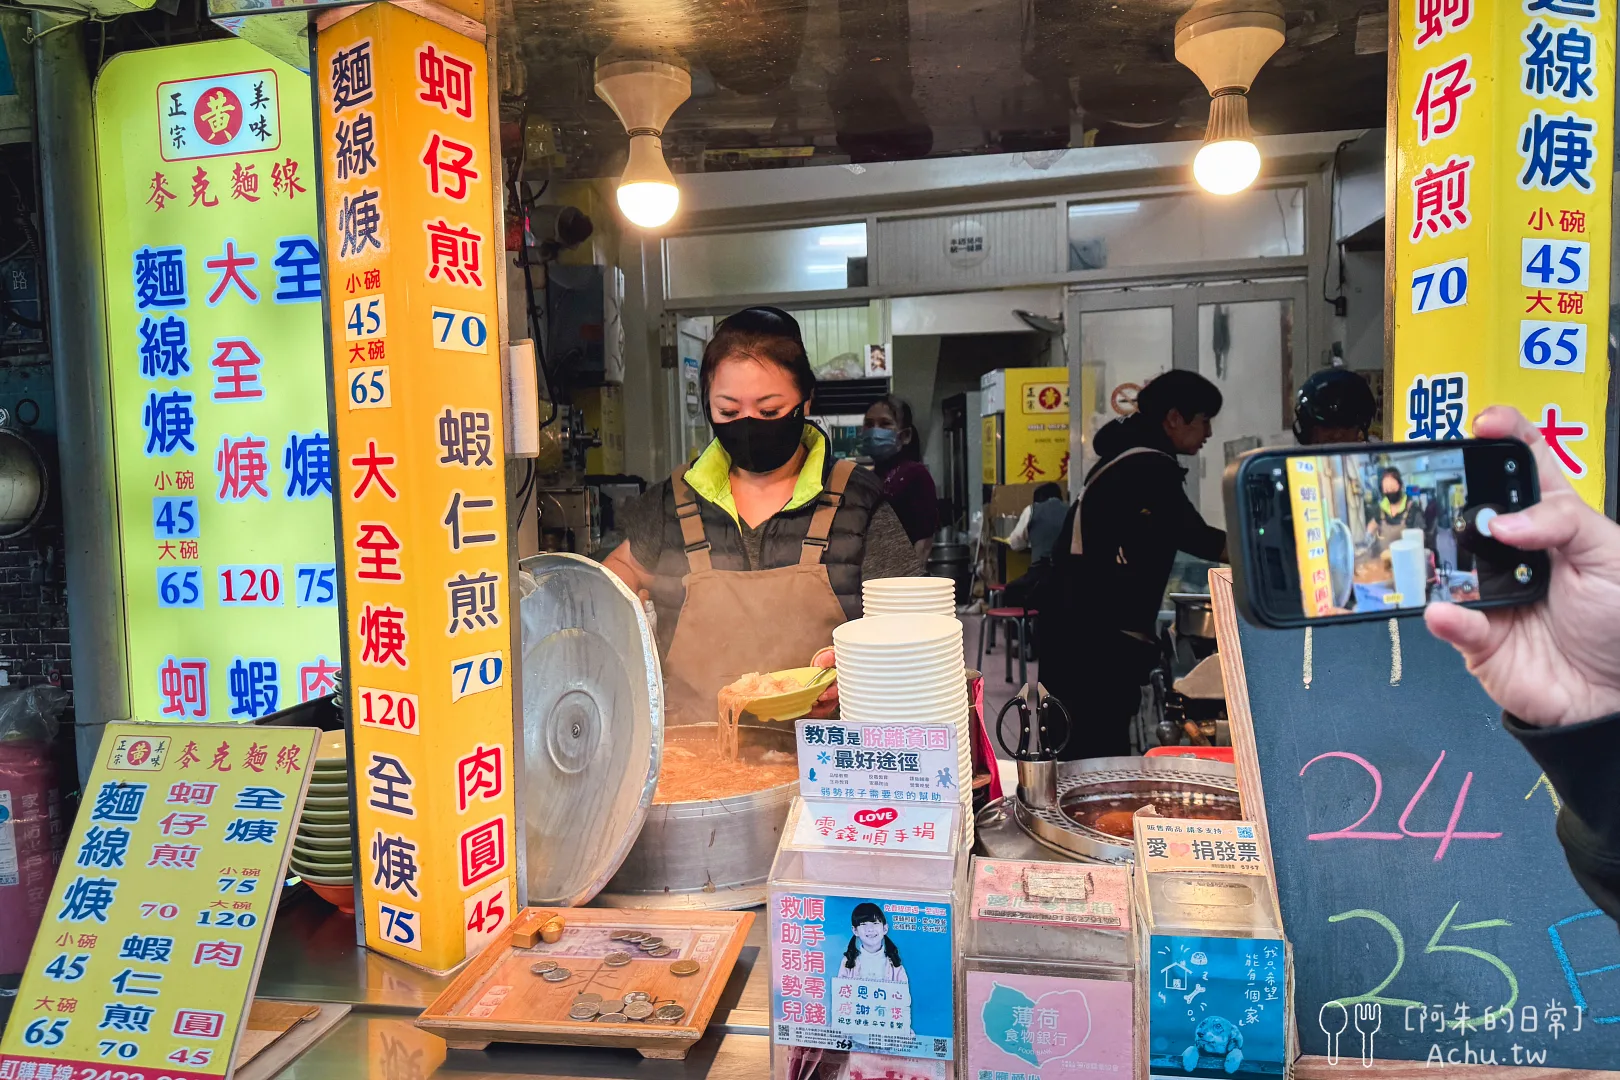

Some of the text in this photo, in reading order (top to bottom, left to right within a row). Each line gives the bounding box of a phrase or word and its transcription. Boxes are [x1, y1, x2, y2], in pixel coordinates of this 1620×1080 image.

[249, 80, 273, 142] 美味
[1521, 0, 1596, 190] 線焿
[167, 92, 188, 150] 正宗
[199, 90, 236, 142] 黃
[418, 45, 483, 288] 蚵仔煎
[146, 157, 307, 213] 麥克麵線
[1527, 206, 1586, 234] 小碗
[12, 270, 27, 290] 路
[345, 268, 381, 294] 小碗
[1526, 243, 1582, 285] 45
[1411, 265, 1468, 311] 70
[1525, 289, 1584, 315] 大碗
[347, 299, 382, 337] 45
[431, 310, 487, 348] 70
[349, 338, 385, 364] 大碗
[1522, 326, 1580, 366] 65
[350, 369, 385, 404] 65
[154, 469, 195, 491] 小碗
[1296, 461, 1314, 472] 70
[155, 499, 195, 535] 45
[438, 407, 500, 635] 蝦仁煎
[157, 539, 199, 561] 大碗
[160, 570, 200, 605] 65
[219, 567, 281, 603] 120
[297, 567, 336, 604] 75
[161, 658, 207, 717] 蚵
[229, 659, 280, 719] 蝦
[300, 658, 342, 704] 肉
[452, 656, 503, 694] 70
[360, 690, 416, 730] 120
[113, 739, 127, 765] 正宗
[150, 740, 165, 768] 美味
[804, 724, 948, 749] 教育是脫離貧困
[174, 739, 301, 775] 麥克麵線
[834, 749, 920, 772] 最好途徑
[820, 786, 942, 802] 弱勢孩子需要您的幫助
[1298, 750, 1503, 863] 24
[148, 782, 219, 869] 蚵仔煎
[457, 745, 506, 888] 肉圓
[814, 816, 936, 846] 零錢順手捐
[859, 810, 894, 823] LOVE
[1191, 839, 1261, 863] 捐發票
[217, 878, 256, 894] 75
[218, 866, 261, 879] 小碗
[140, 903, 179, 919] 70
[196, 911, 257, 928] 120
[208, 899, 253, 911] 大碗
[466, 890, 506, 935] 45
[55, 932, 98, 950] 小碗
[379, 904, 416, 945] 75
[45, 955, 90, 981] 45
[780, 896, 803, 1024] 救助弱勢兒
[802, 897, 827, 1025] 順手捐零錢
[1263, 945, 1279, 1001] 我只希望
[1326, 900, 1520, 1029] 25
[98, 936, 174, 1033] 蝦仁煎
[172, 941, 244, 1039] 肉圓
[838, 984, 903, 1001] 感恩的心
[33, 996, 78, 1014] 大碗
[838, 1001, 904, 1020] 感謝有您
[1012, 1005, 1060, 1031] 薄荷
[24, 1018, 70, 1046] 65
[1004, 1028, 1068, 1047] 食物銀行
[99, 1042, 139, 1059] 70
[167, 1048, 214, 1066] 45
